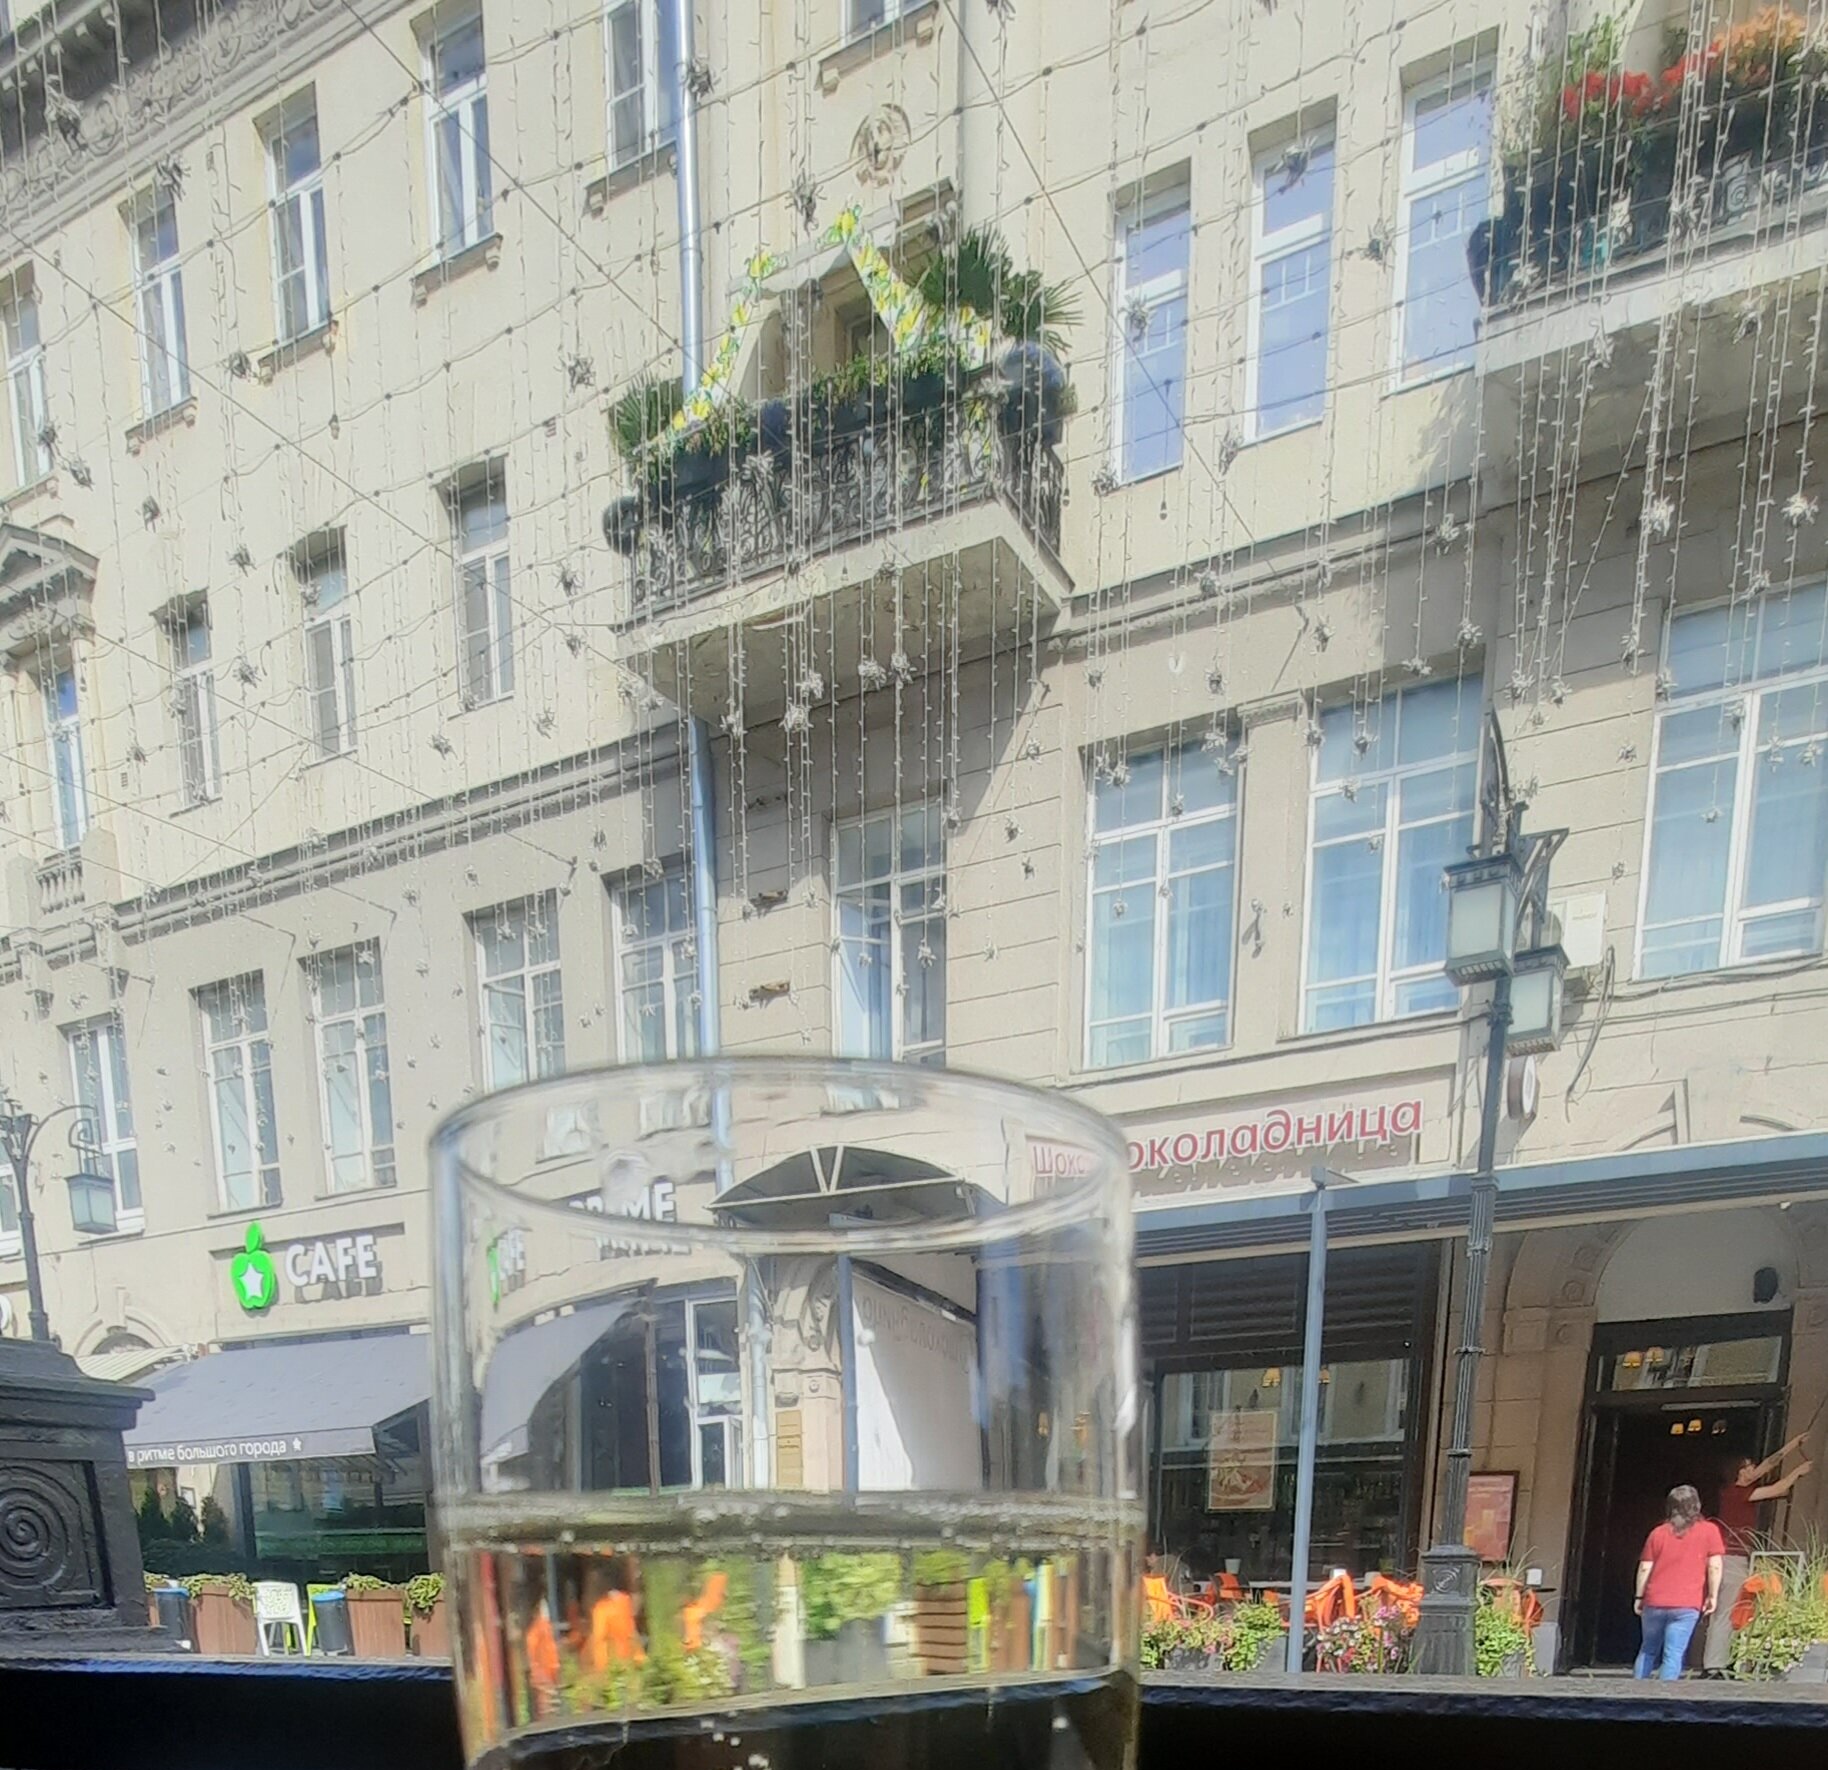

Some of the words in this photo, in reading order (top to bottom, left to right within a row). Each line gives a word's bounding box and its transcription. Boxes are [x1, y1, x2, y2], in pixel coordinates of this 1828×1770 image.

[285, 1234, 378, 1287] CAFE
[137, 1447, 176, 1466] ритме
[177, 1443, 237, 1461] большого
[239, 1438, 287, 1458] города
